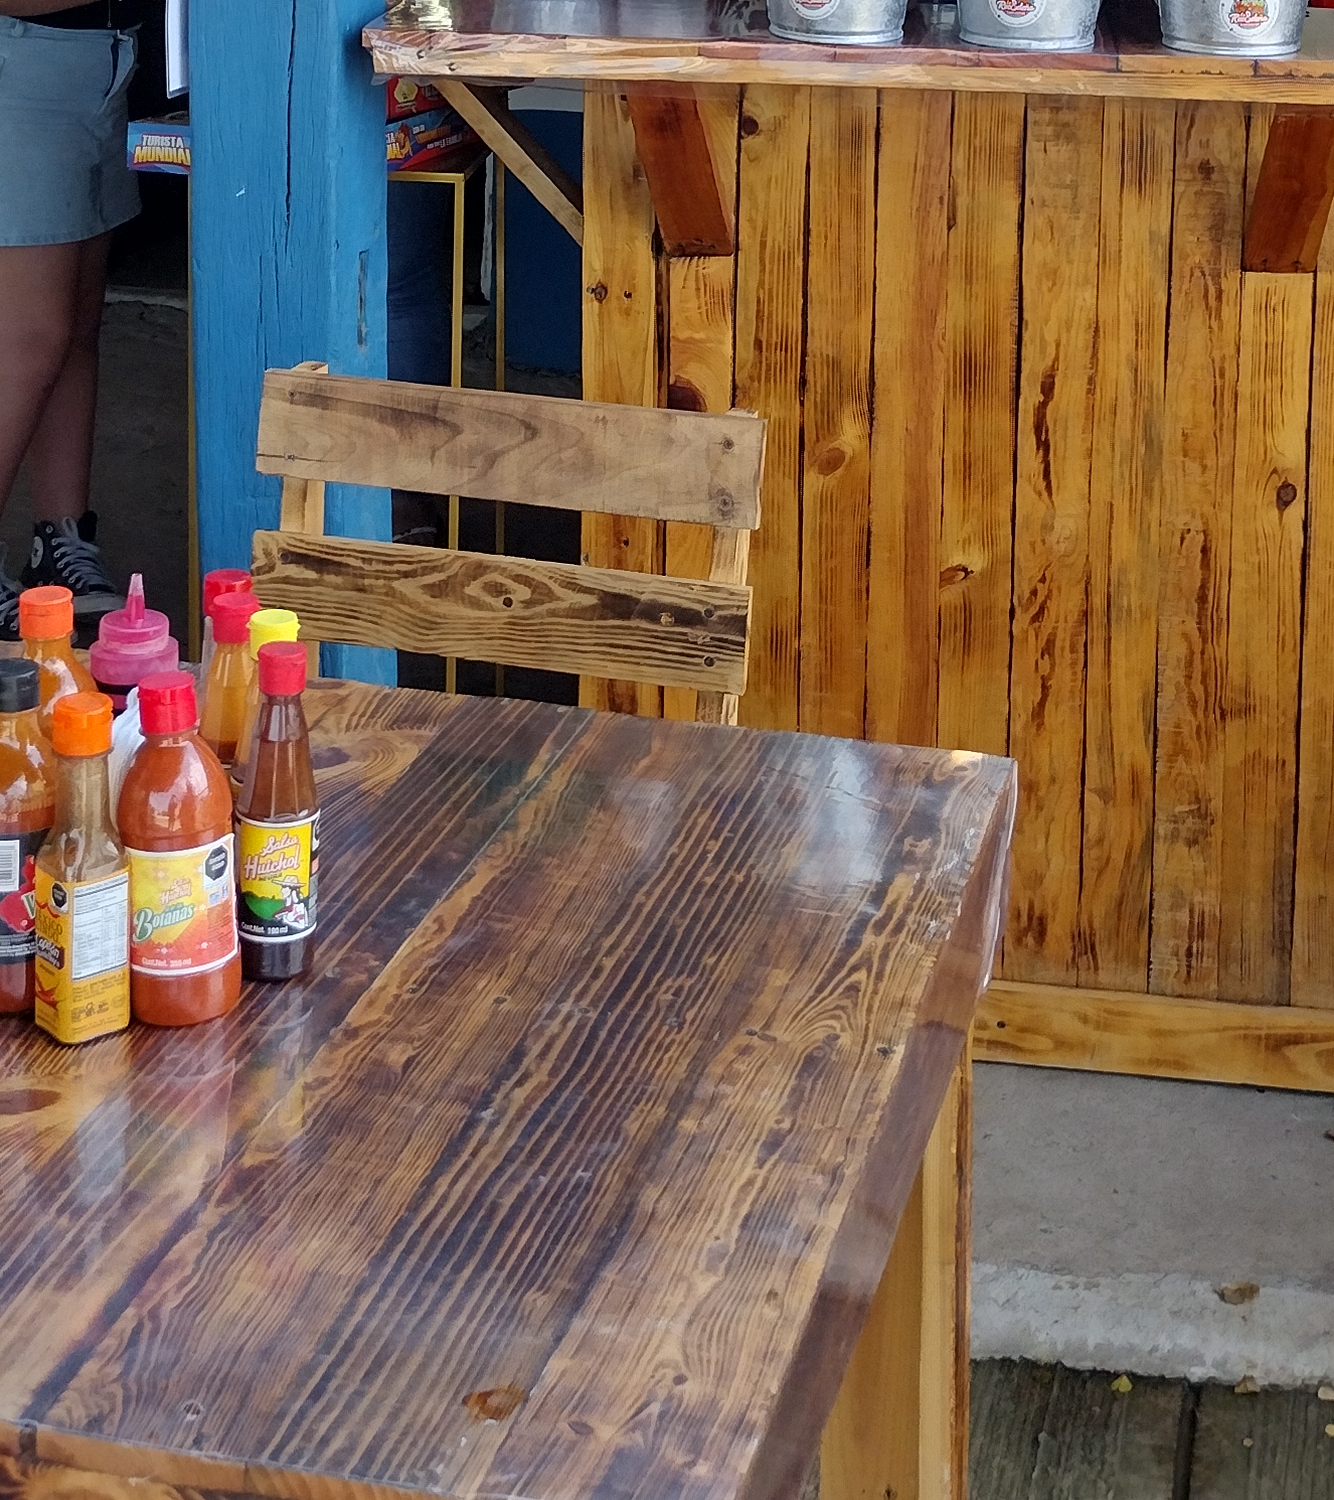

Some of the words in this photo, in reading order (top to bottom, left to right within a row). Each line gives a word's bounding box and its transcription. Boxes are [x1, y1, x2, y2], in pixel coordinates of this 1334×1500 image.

[142, 134, 185, 149] TURISTA
[261, 832, 300, 857] Salsa
[243, 844, 301, 879] Huichol
[132, 902, 195, 942] Botanas
